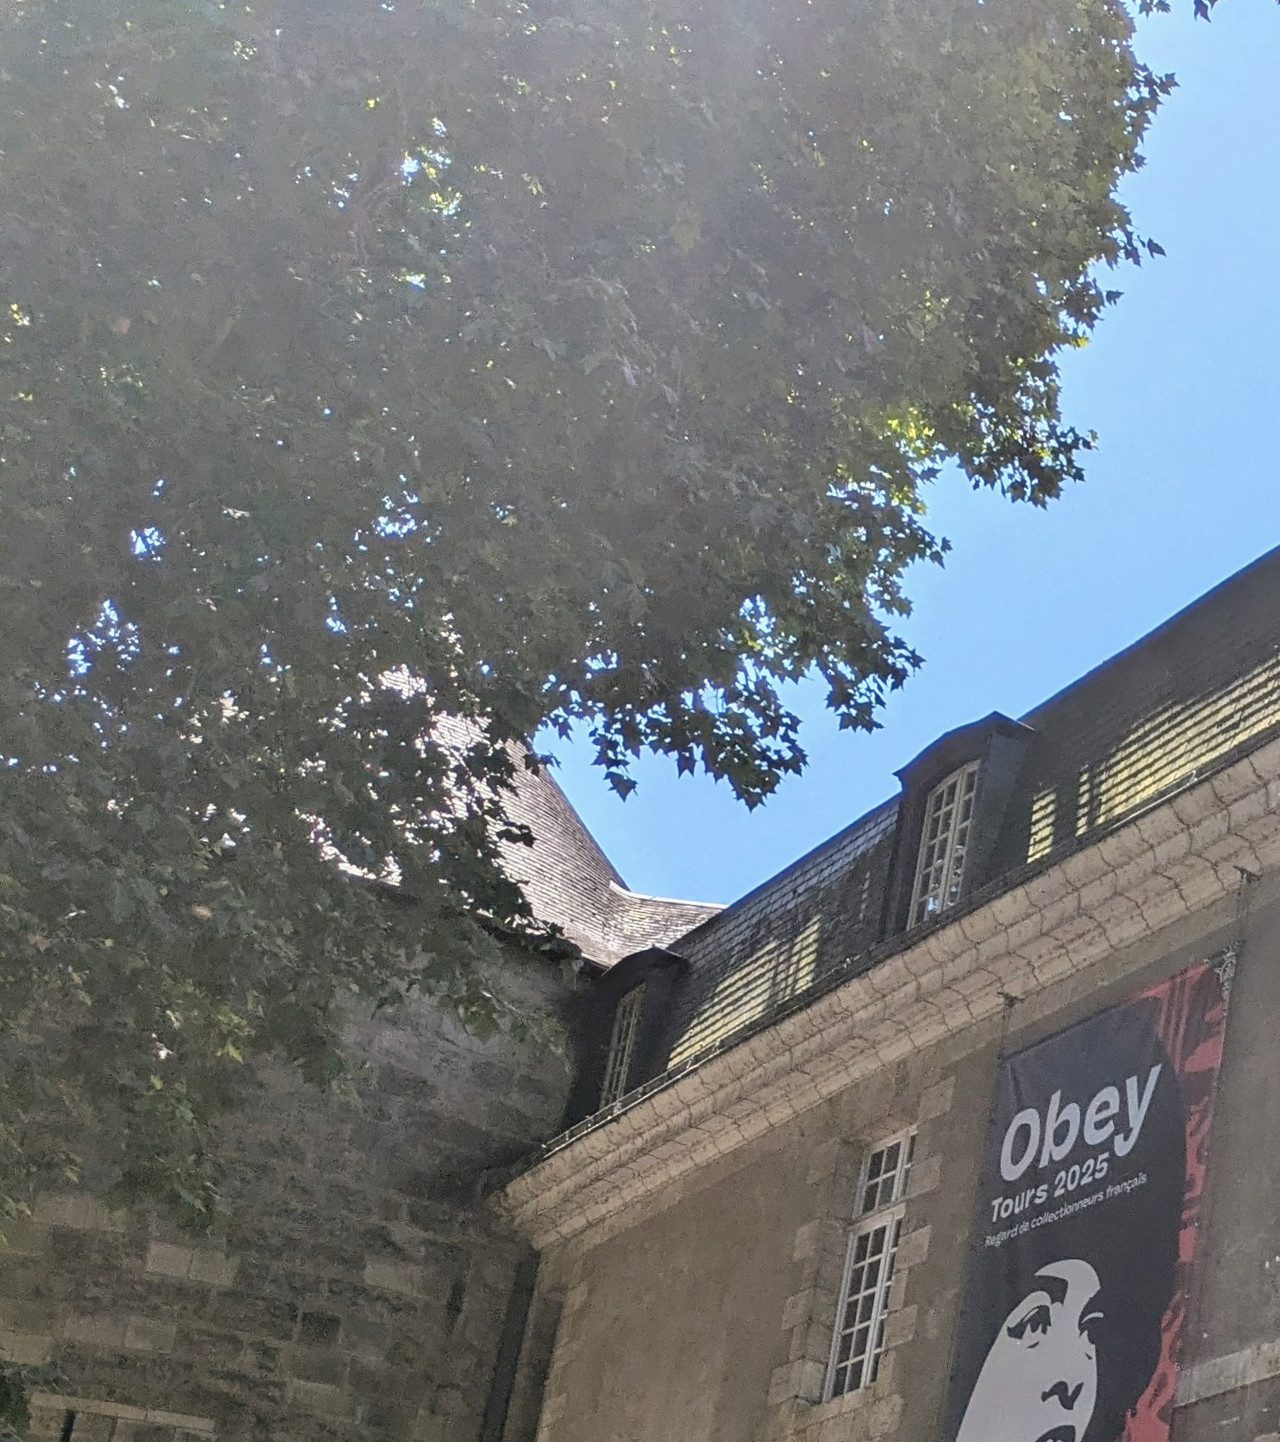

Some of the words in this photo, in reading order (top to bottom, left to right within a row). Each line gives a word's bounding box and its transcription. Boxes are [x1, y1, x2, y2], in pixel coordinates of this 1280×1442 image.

[1000, 1063, 1162, 1182] Obey
[991, 1183, 1049, 1223] Tours
[1053, 1152, 1110, 1198] 2025
[1030, 1190, 1104, 1228] collectionneurs
[1105, 1171, 1148, 1199] français
